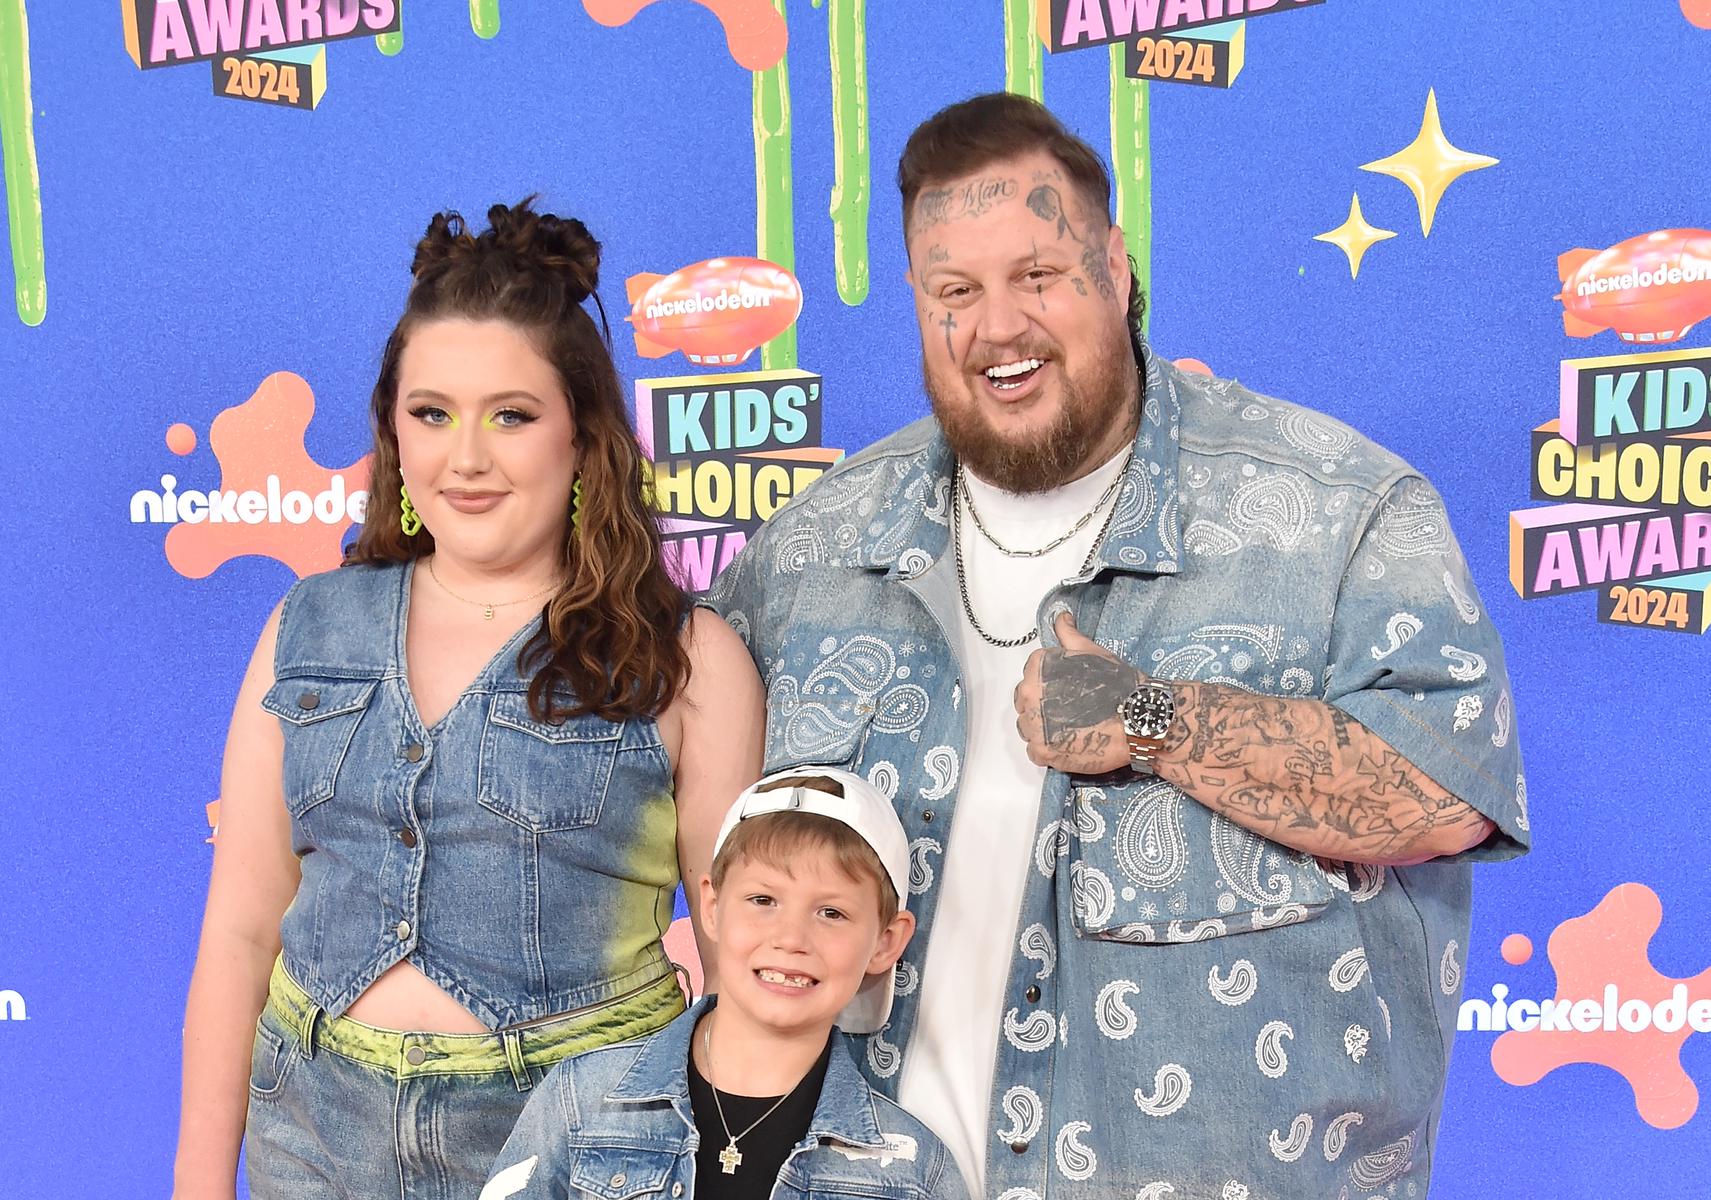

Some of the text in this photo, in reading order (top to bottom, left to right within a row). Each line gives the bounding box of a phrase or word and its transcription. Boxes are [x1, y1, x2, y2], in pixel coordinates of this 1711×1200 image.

[150, 0, 395, 63] AWARDS
[223, 57, 299, 103] 2024
[1136, 37, 1215, 82] 2024
[1577, 262, 1711, 296] nickelodeon
[646, 288, 770, 319] nickelodeon
[668, 383, 820, 454] KIDS'
[1594, 366, 1711, 437] KID
[1609, 585, 1688, 628] 2024
[1457, 983, 1711, 1033] nickelode
